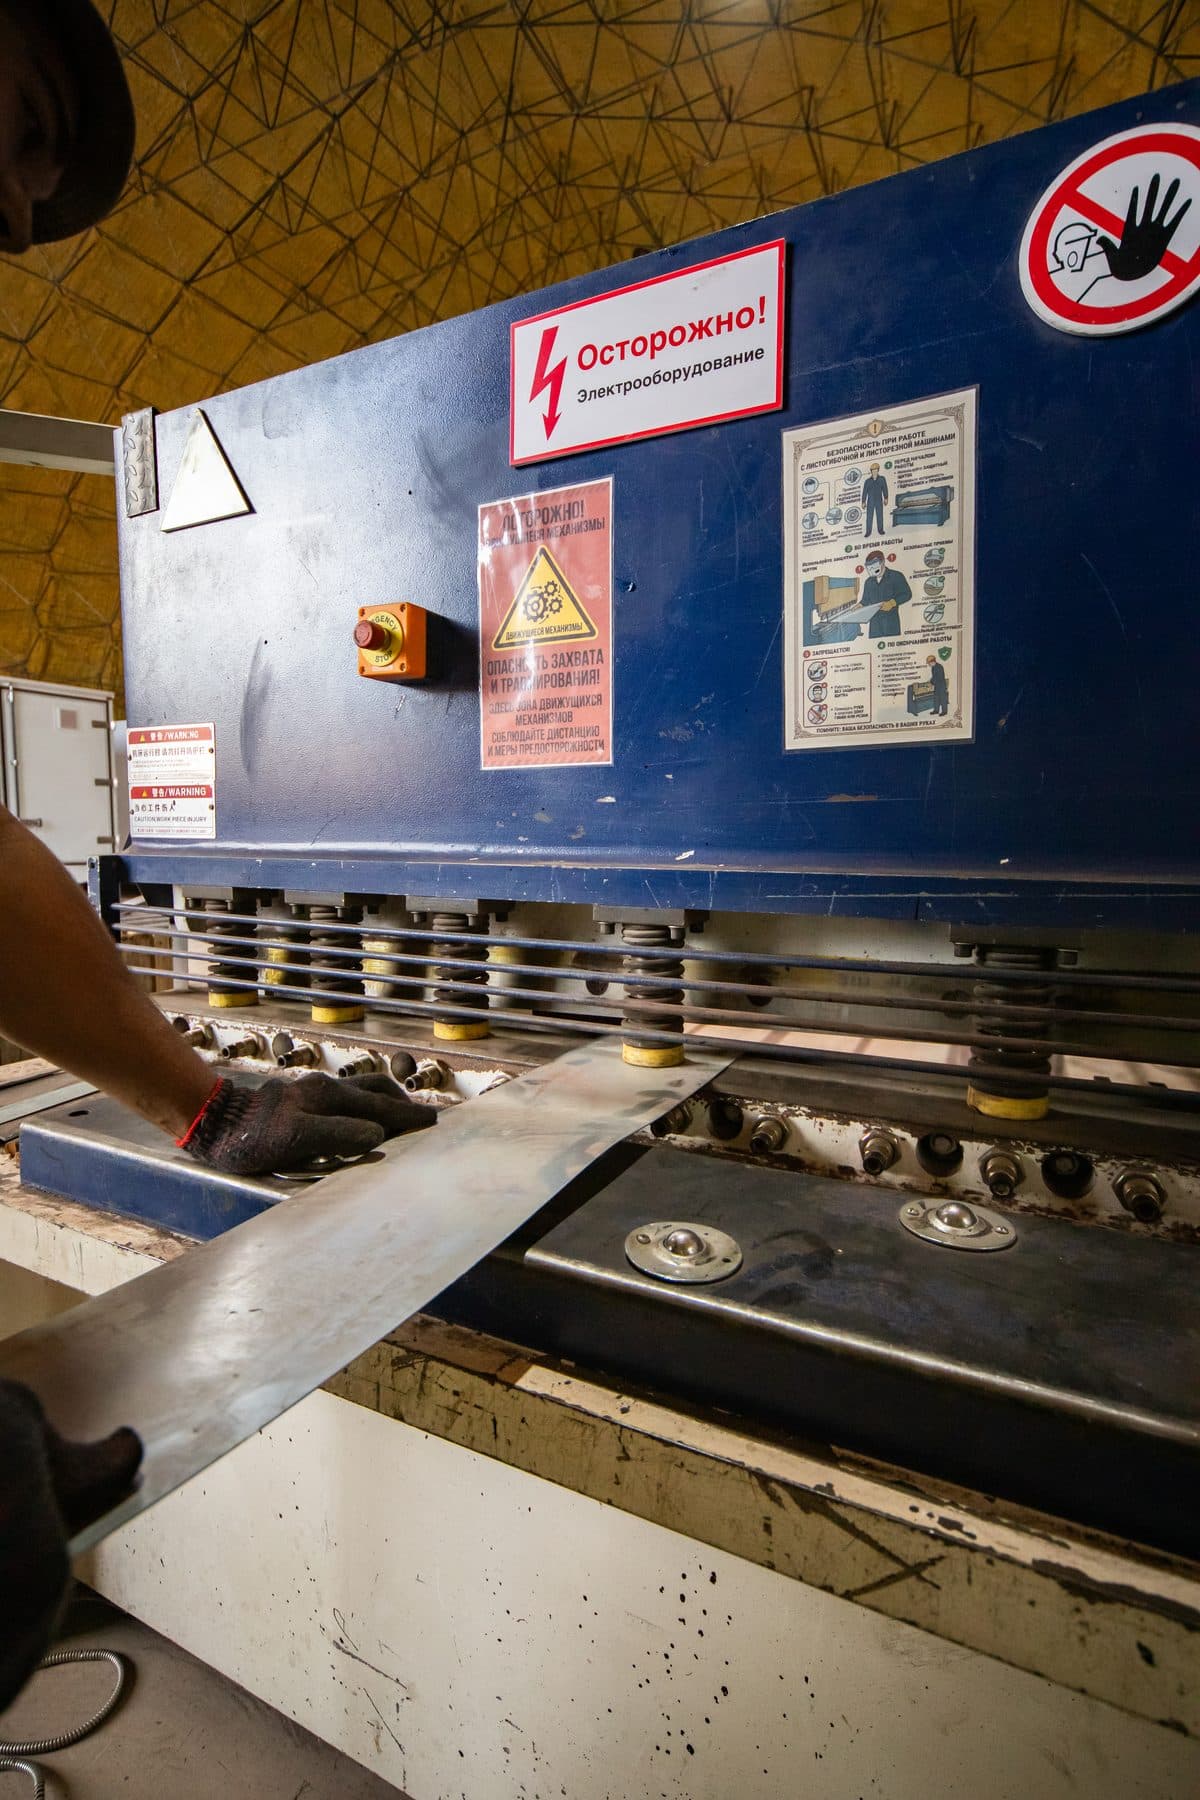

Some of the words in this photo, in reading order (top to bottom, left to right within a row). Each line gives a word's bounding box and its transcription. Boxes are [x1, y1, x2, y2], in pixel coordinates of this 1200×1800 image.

[577, 295, 767, 371] Осторожно!
[577, 346, 765, 404] Электрооборудование
[806, 453, 859, 470] ЛИСТОГИБОЧНОЙ
[866, 441, 913, 458] ЛИСТОРЕЗНОЙ
[914, 433, 956, 448] МАШИНАМИ
[827, 441, 880, 458] БЕЗОПАСНОСТЬ
[882, 437, 897, 446] ПРИ
[898, 431, 926, 442] РАБОТЕ
[502, 500, 585, 530] ОСТОРОЖНО!
[546, 517, 606, 540] МЕХАНИЗМЫ
[862, 542, 880, 550] ВРЕМЯ
[881, 538, 903, 546] РАБОТЫ
[372, 615, 398, 630] GENCY
[545, 622, 583, 635] МЕХАНИЗМЫ
[375, 650, 393, 663] STOP
[487, 655, 549, 676] ОПАСНОТЬ
[551, 648, 605, 669] ЗАХВАТА
[490, 678, 498, 694] И
[539, 694, 603, 712] ДВИЖУЩИХСЯ
[515, 711, 574, 726] МЕХАНИЗМОВ
[857, 723, 894, 731] БЕЗОПАСНОСТЬ
[491, 727, 545, 744] СОБЛЮДАЙТЕ
[546, 725, 600, 741] ДИСТАНЦИЮ
[487, 745, 493, 757] И
[494, 743, 518, 756] МЕРЫ
[518, 739, 605, 755] ПРЕДОСТОРОЖНОСТИ
